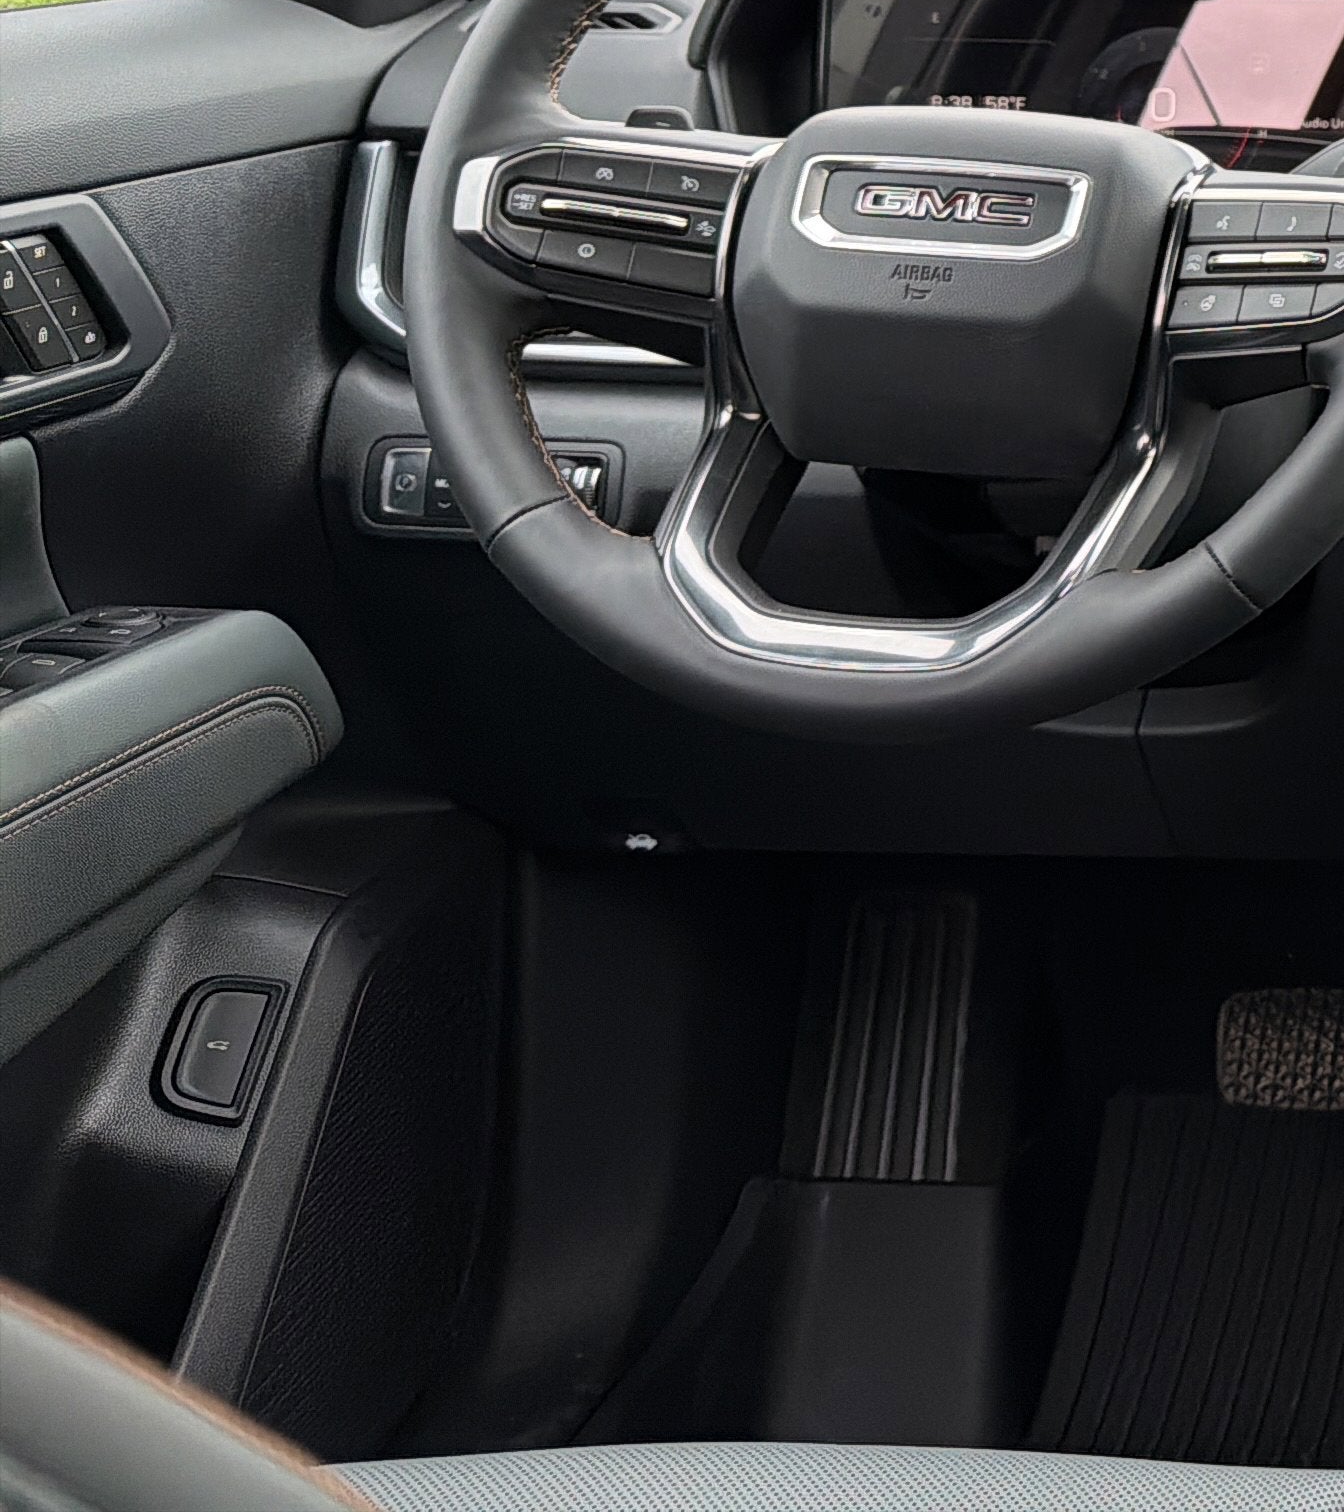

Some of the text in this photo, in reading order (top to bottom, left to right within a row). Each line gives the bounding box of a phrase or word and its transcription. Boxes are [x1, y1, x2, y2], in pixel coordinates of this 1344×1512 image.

[1152, 88, 1176, 122] 0
[856, 185, 1035, 227] GMC
[890, 264, 954, 282] AIRBAG
